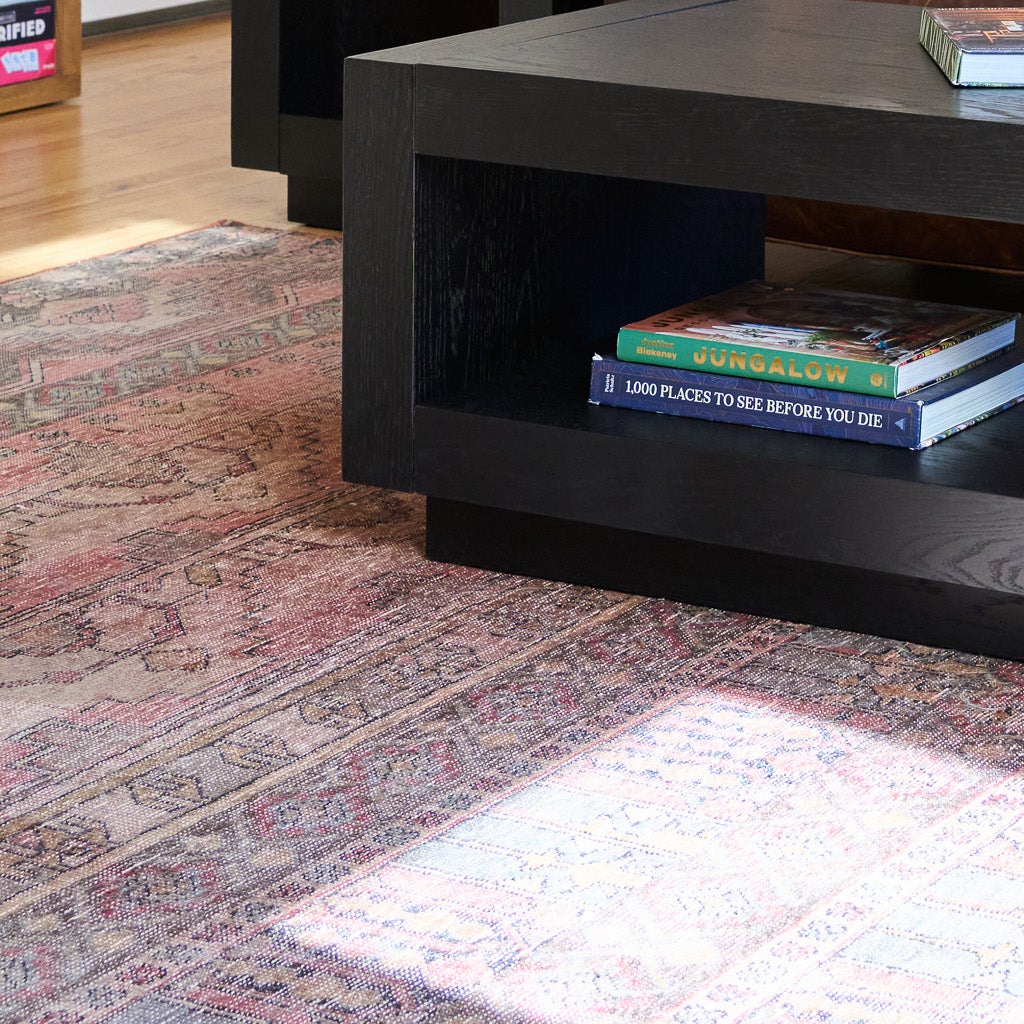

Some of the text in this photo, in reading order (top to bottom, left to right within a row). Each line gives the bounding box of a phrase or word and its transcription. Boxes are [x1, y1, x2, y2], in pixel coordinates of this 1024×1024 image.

[636, 346, 678, 360] Blakeney
[641, 338, 675, 349] Justine
[693, 347, 849, 383] JUNGALOW
[625, 380, 884, 429] 1,000 PLACES TO SEE BEFORE YOU DIE
